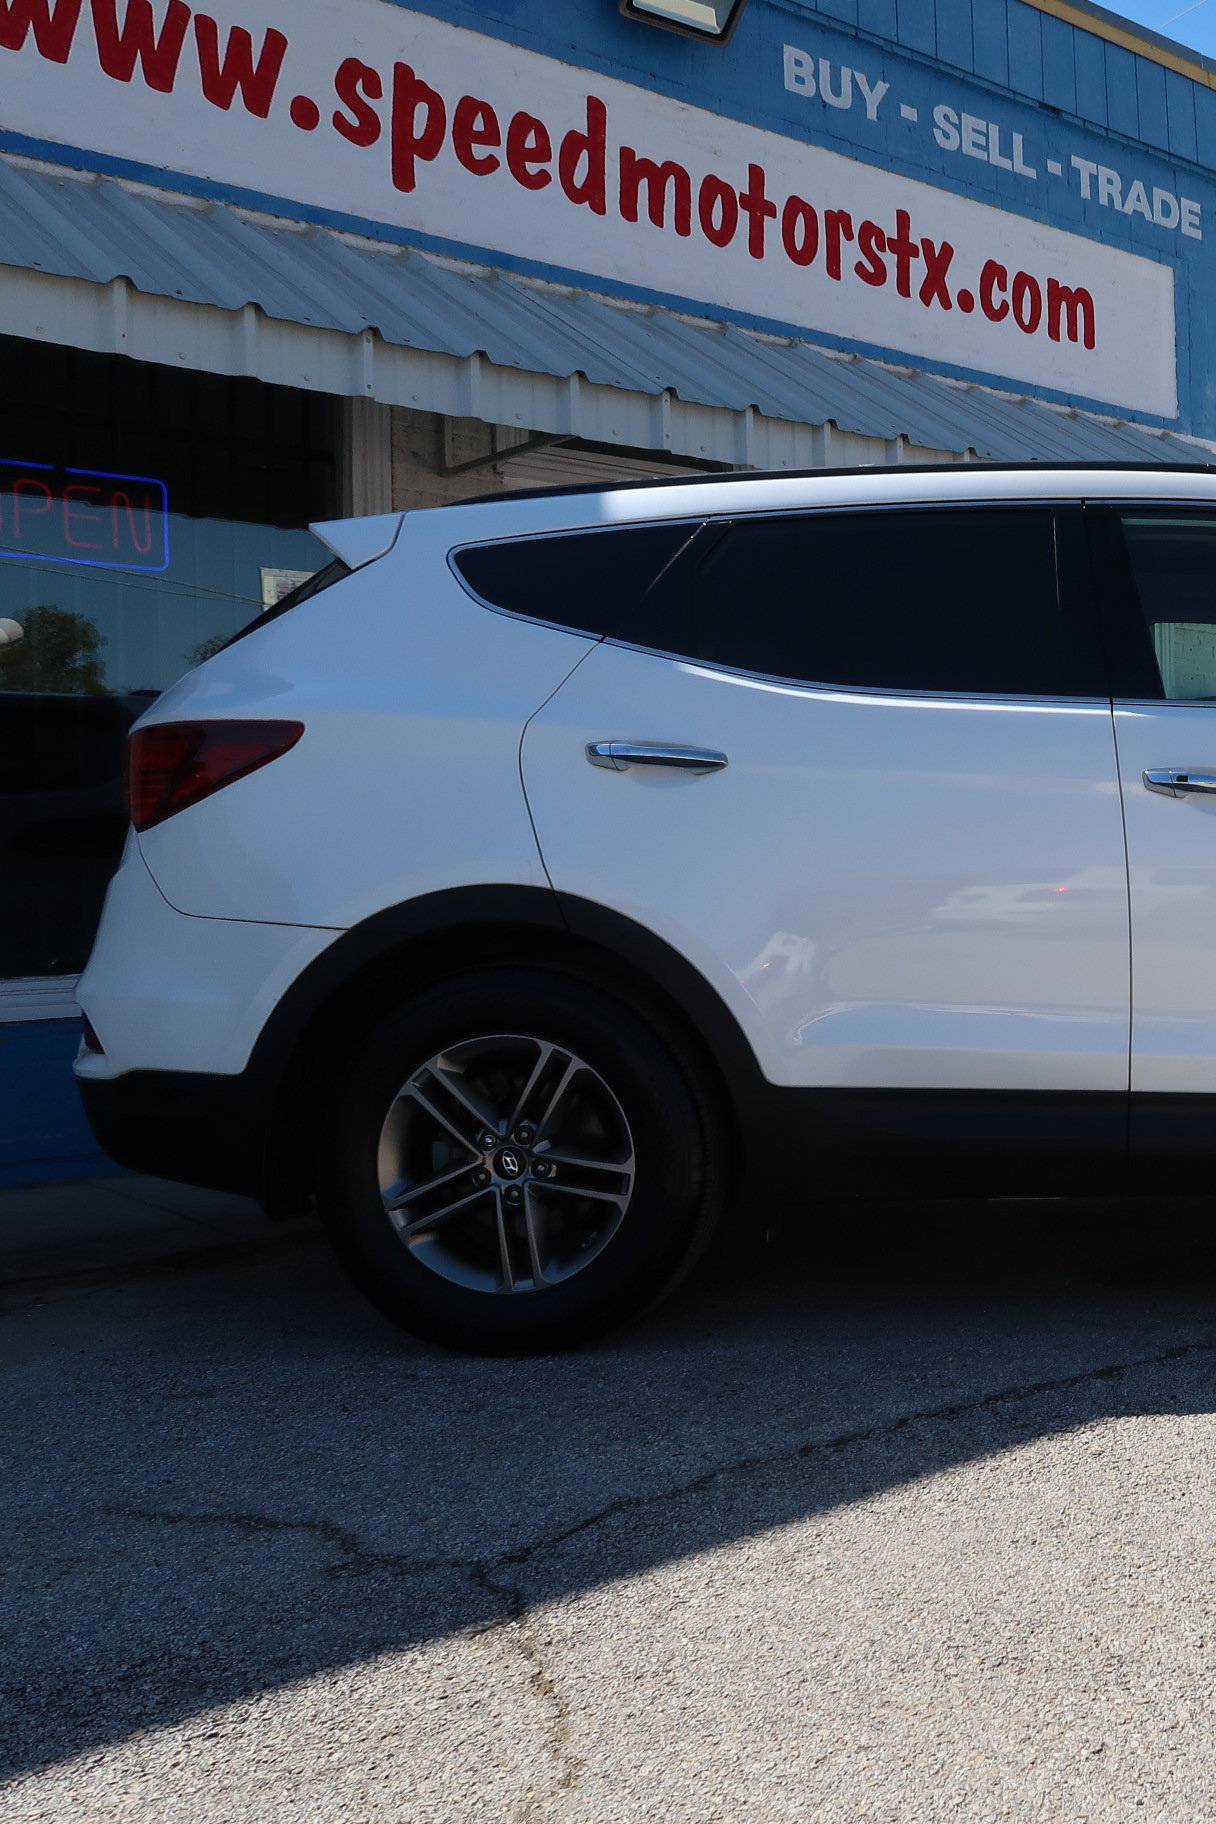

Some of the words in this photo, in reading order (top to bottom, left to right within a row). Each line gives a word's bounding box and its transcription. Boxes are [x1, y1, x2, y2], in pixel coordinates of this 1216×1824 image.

[784, 45, 889, 121] BUY
[934, 105, 1036, 180] SELL
[1071, 155, 1202, 240] TRADE
[0, 479, 152, 552] PEN
